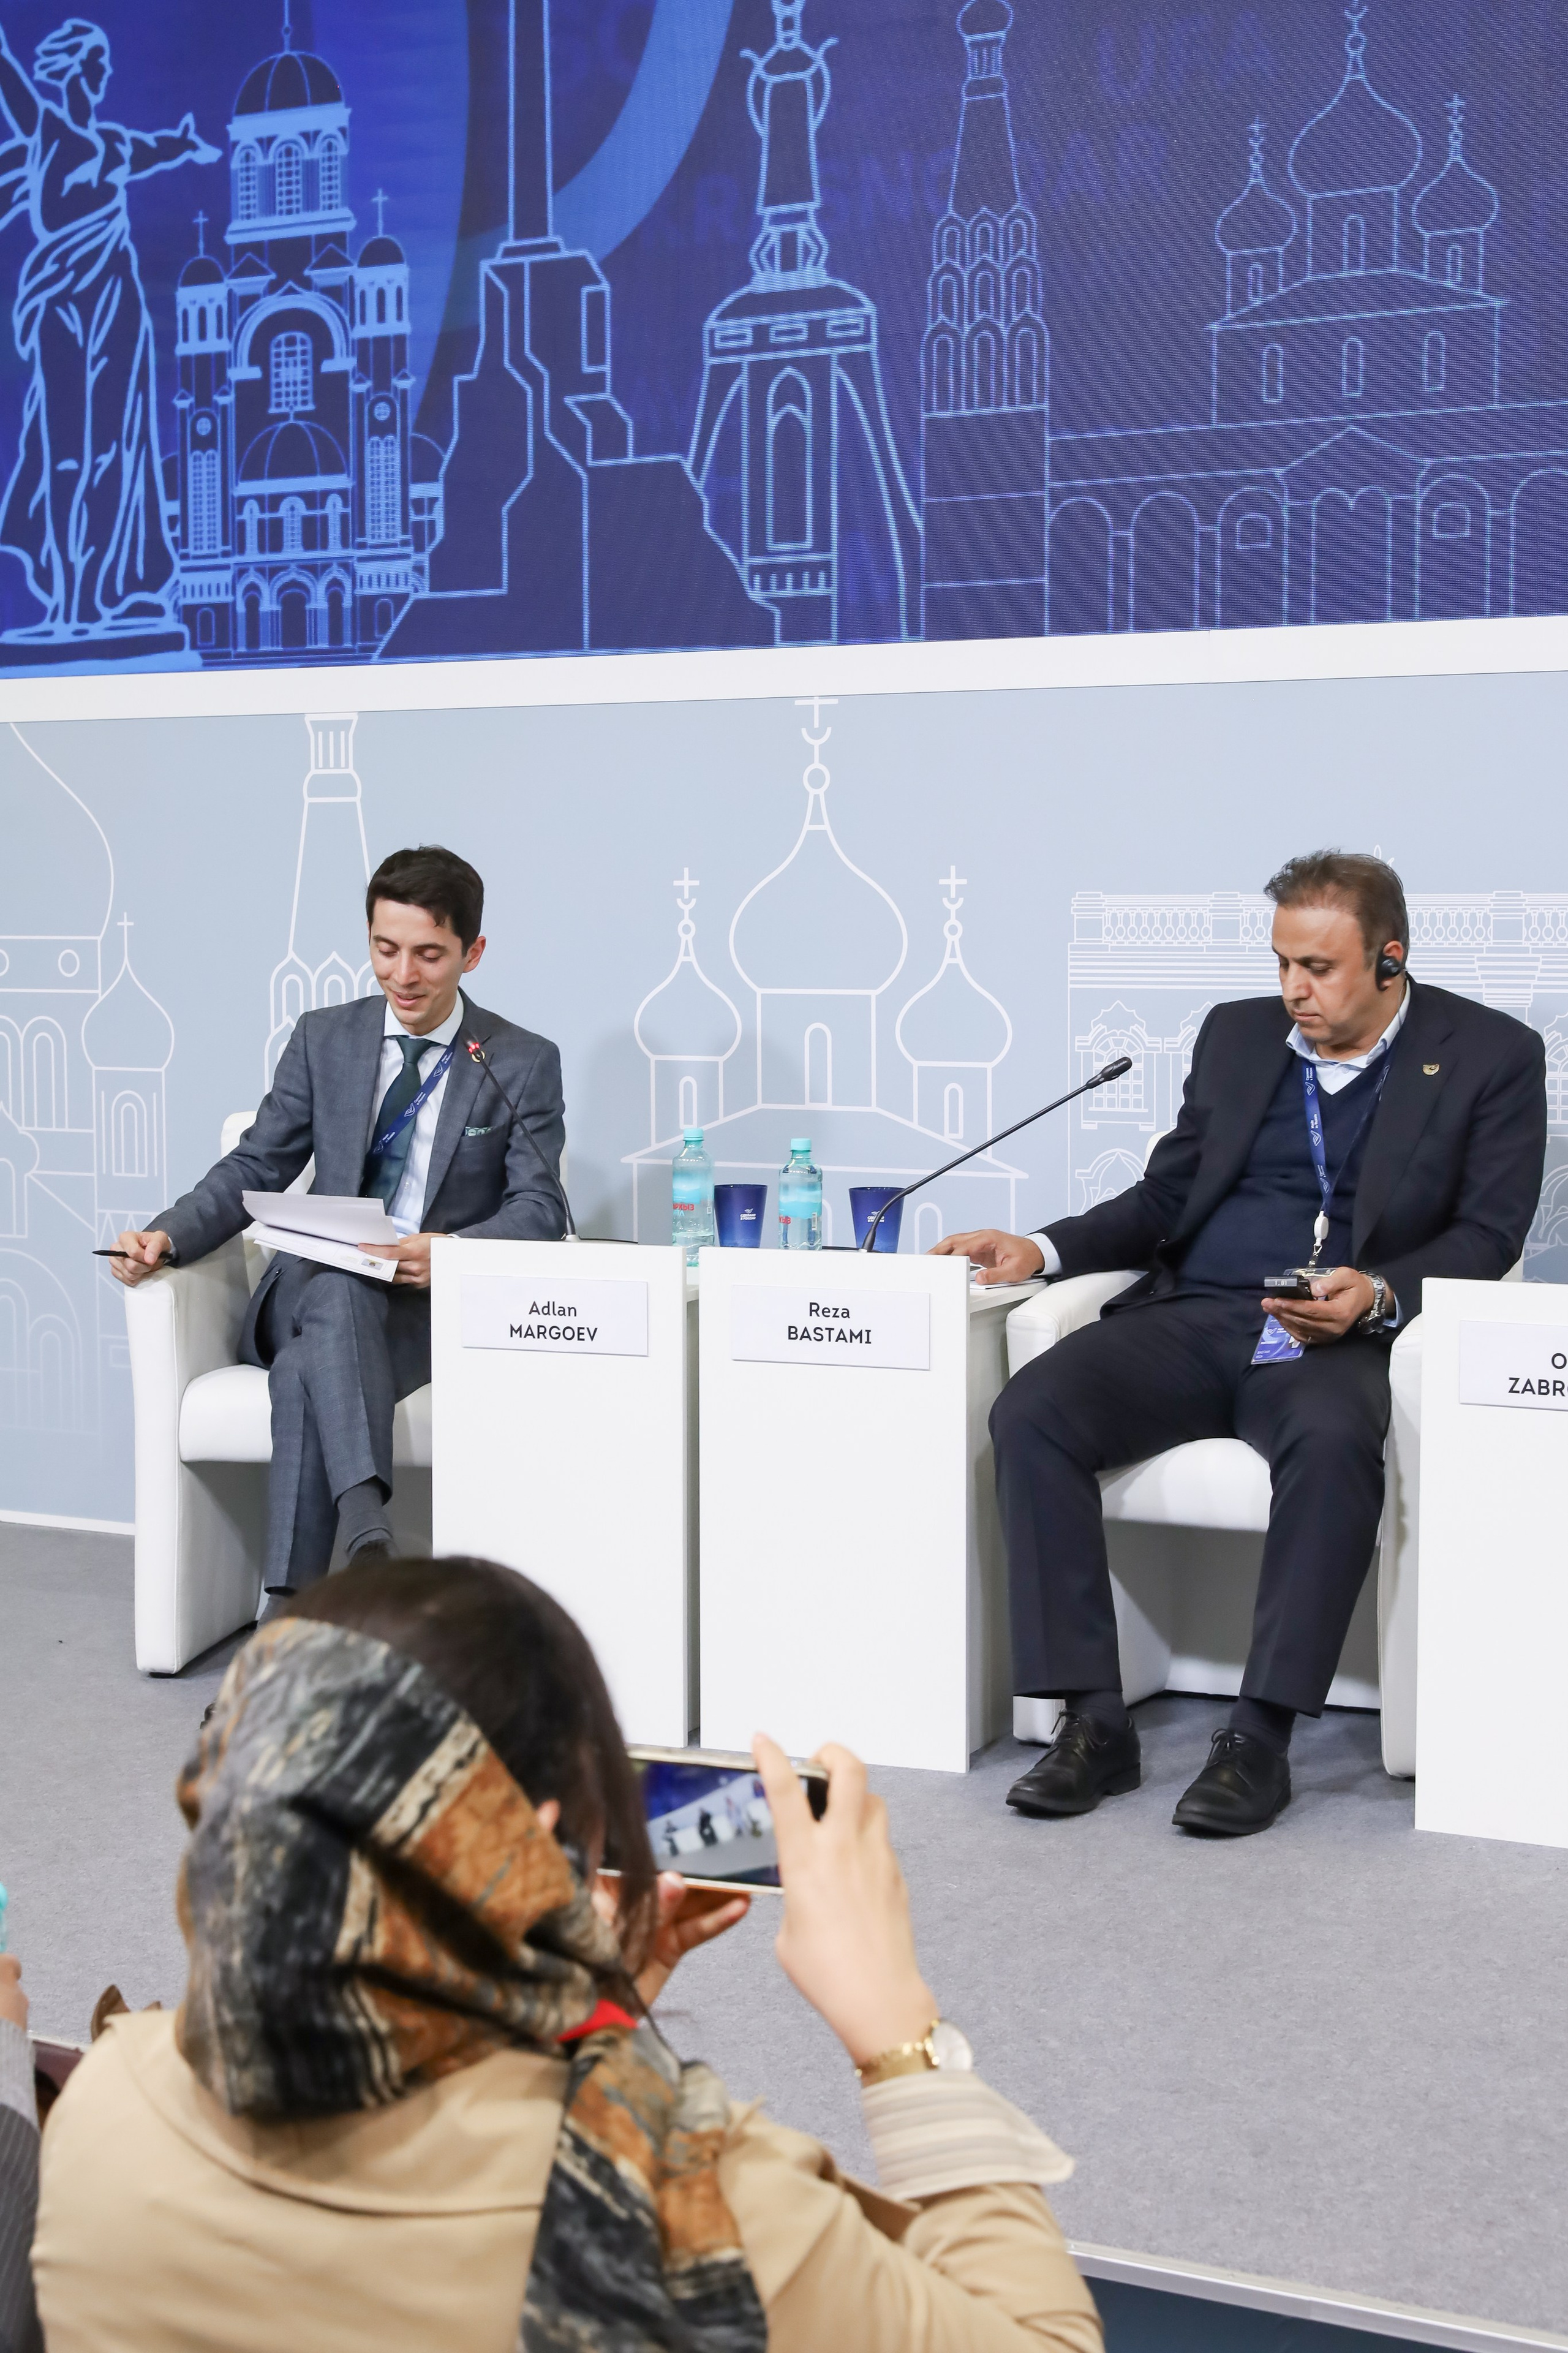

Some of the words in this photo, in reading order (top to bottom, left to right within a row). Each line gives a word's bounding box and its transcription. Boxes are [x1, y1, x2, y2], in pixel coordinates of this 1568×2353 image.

[529, 1301, 577, 1317] Adlan
[809, 1302, 850, 1318] Reza
[510, 1323, 598, 1342] MARGOEV
[788, 1326, 872, 1344] BASTAMI
[1508, 1377, 1568, 1397] ZABR
